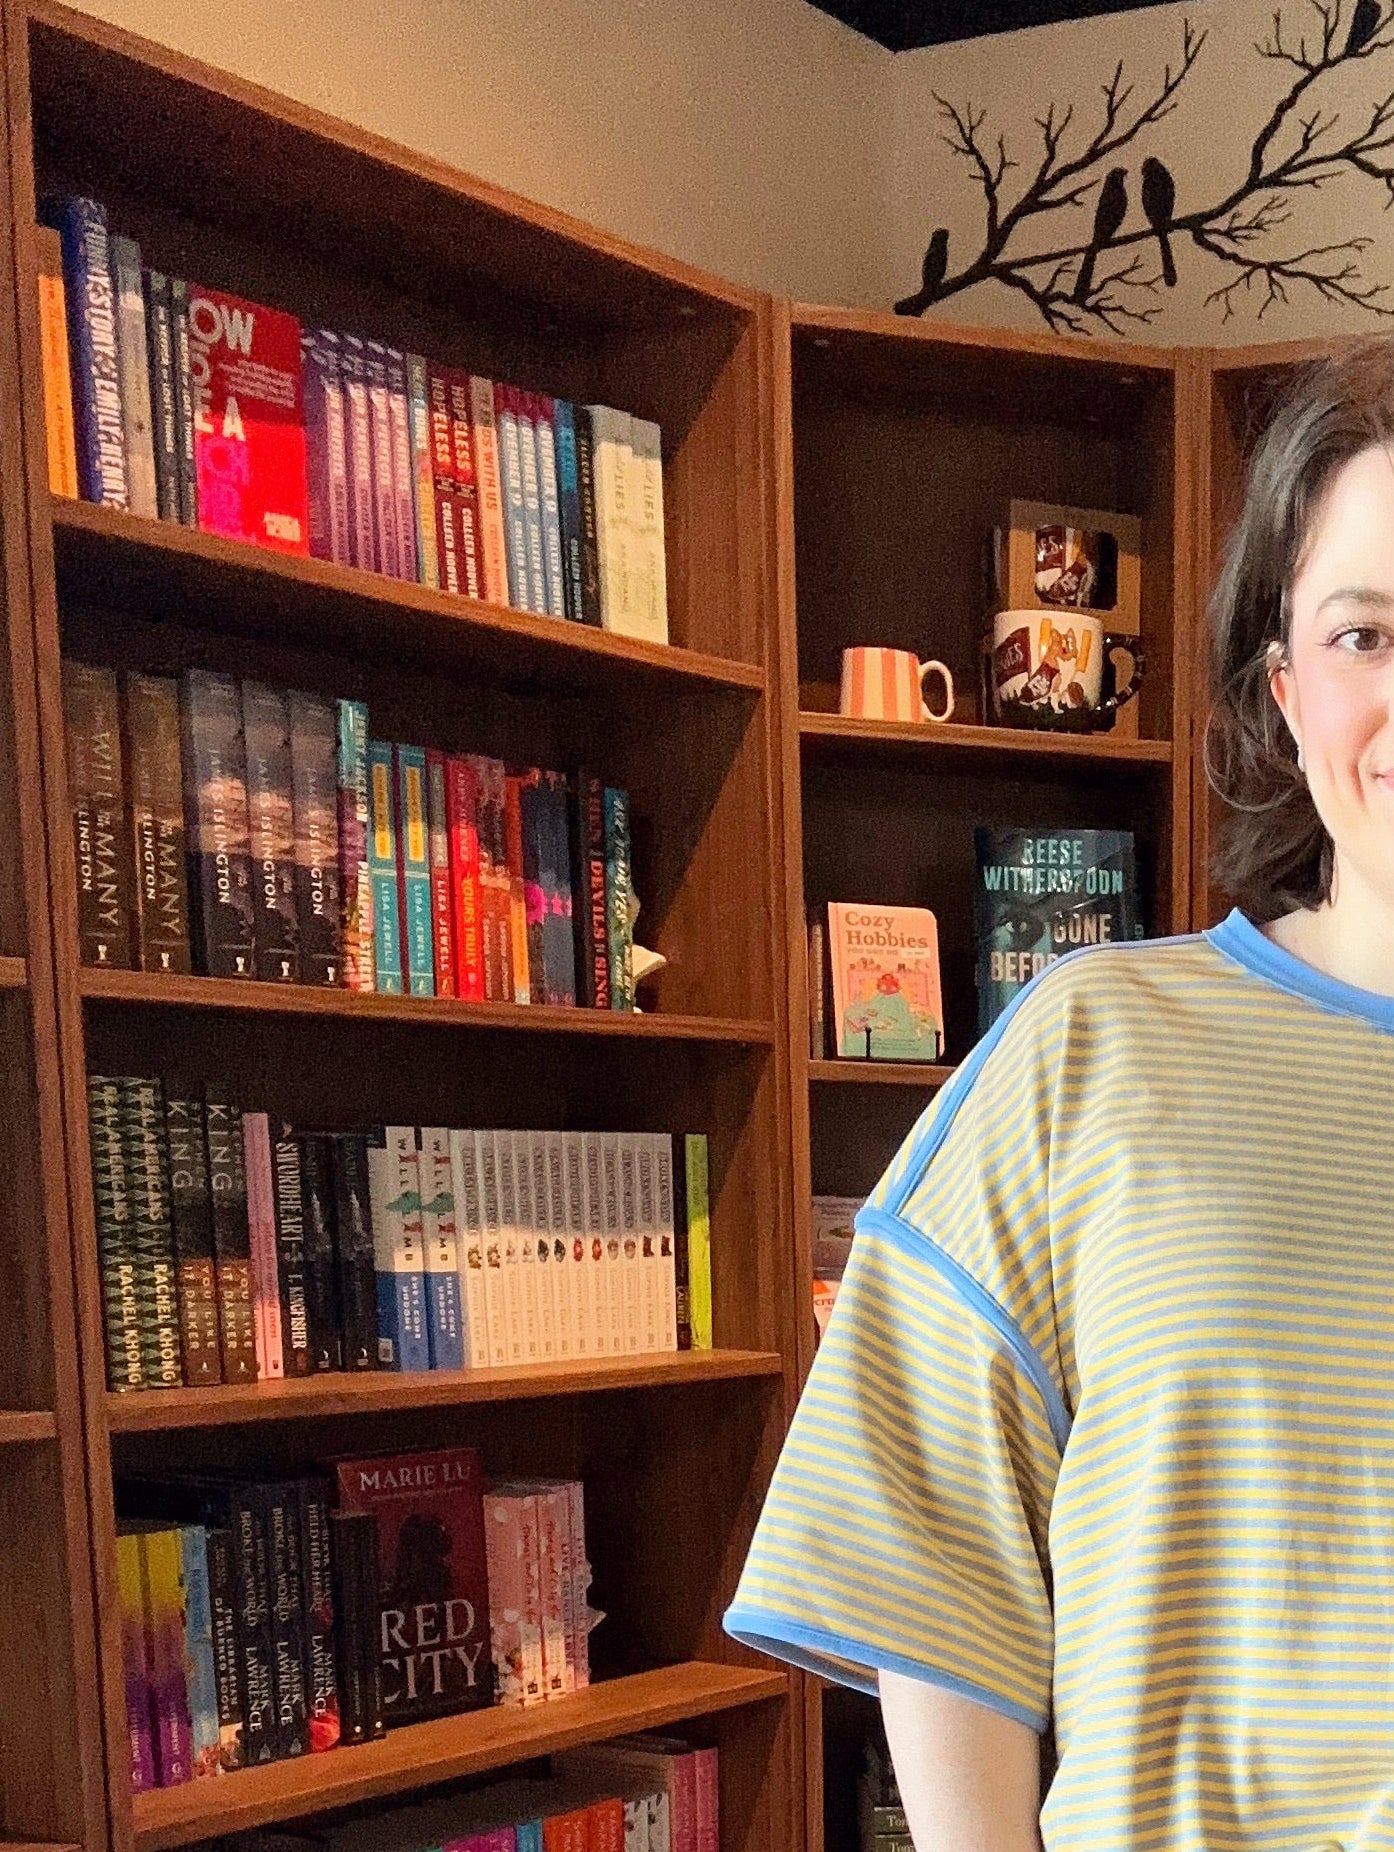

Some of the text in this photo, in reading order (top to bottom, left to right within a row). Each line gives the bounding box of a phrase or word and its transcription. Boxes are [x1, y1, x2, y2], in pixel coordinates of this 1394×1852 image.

[190, 298, 254, 356] OW
[431, 378, 449, 464] HOPELESS
[452, 386, 470, 470] HOPELESS
[97, 832, 120, 926] MANY
[212, 810, 230, 904] ISLINGTON
[260, 816, 276, 910] ISLINGTON
[308, 824, 324, 915] ISLINGTON
[1022, 839, 1083, 865] REESE
[158, 844, 180, 934] MANY
[590, 860, 609, 1007] DEVILS SING
[845, 911, 895, 932] Cozy
[846, 930, 928, 948] Hobbies
[1054, 911, 1112, 943] GONE
[990, 951, 1059, 982] BEFO
[167, 1101, 192, 1189] KING
[207, 1105, 233, 1191] KING
[275, 1142, 305, 1242] SWORDHEART
[118, 1265, 135, 1323] RACHEL
[152, 1264, 172, 1322] RACHEL
[185, 1290, 200, 1350] DARKER
[224, 1291, 238, 1349] DARKER
[125, 1329, 141, 1384] KHONG
[158, 1328, 176, 1381] KHONG
[358, 1461, 472, 1492] MARIE LU
[381, 1598, 475, 1653] RED
[245, 1647, 263, 1732] LAWRENCE
[276, 1642, 293, 1726] LAWRENCE
[311, 1635, 326, 1718] LAWRENCE
[382, 1642, 484, 1703] CITY
